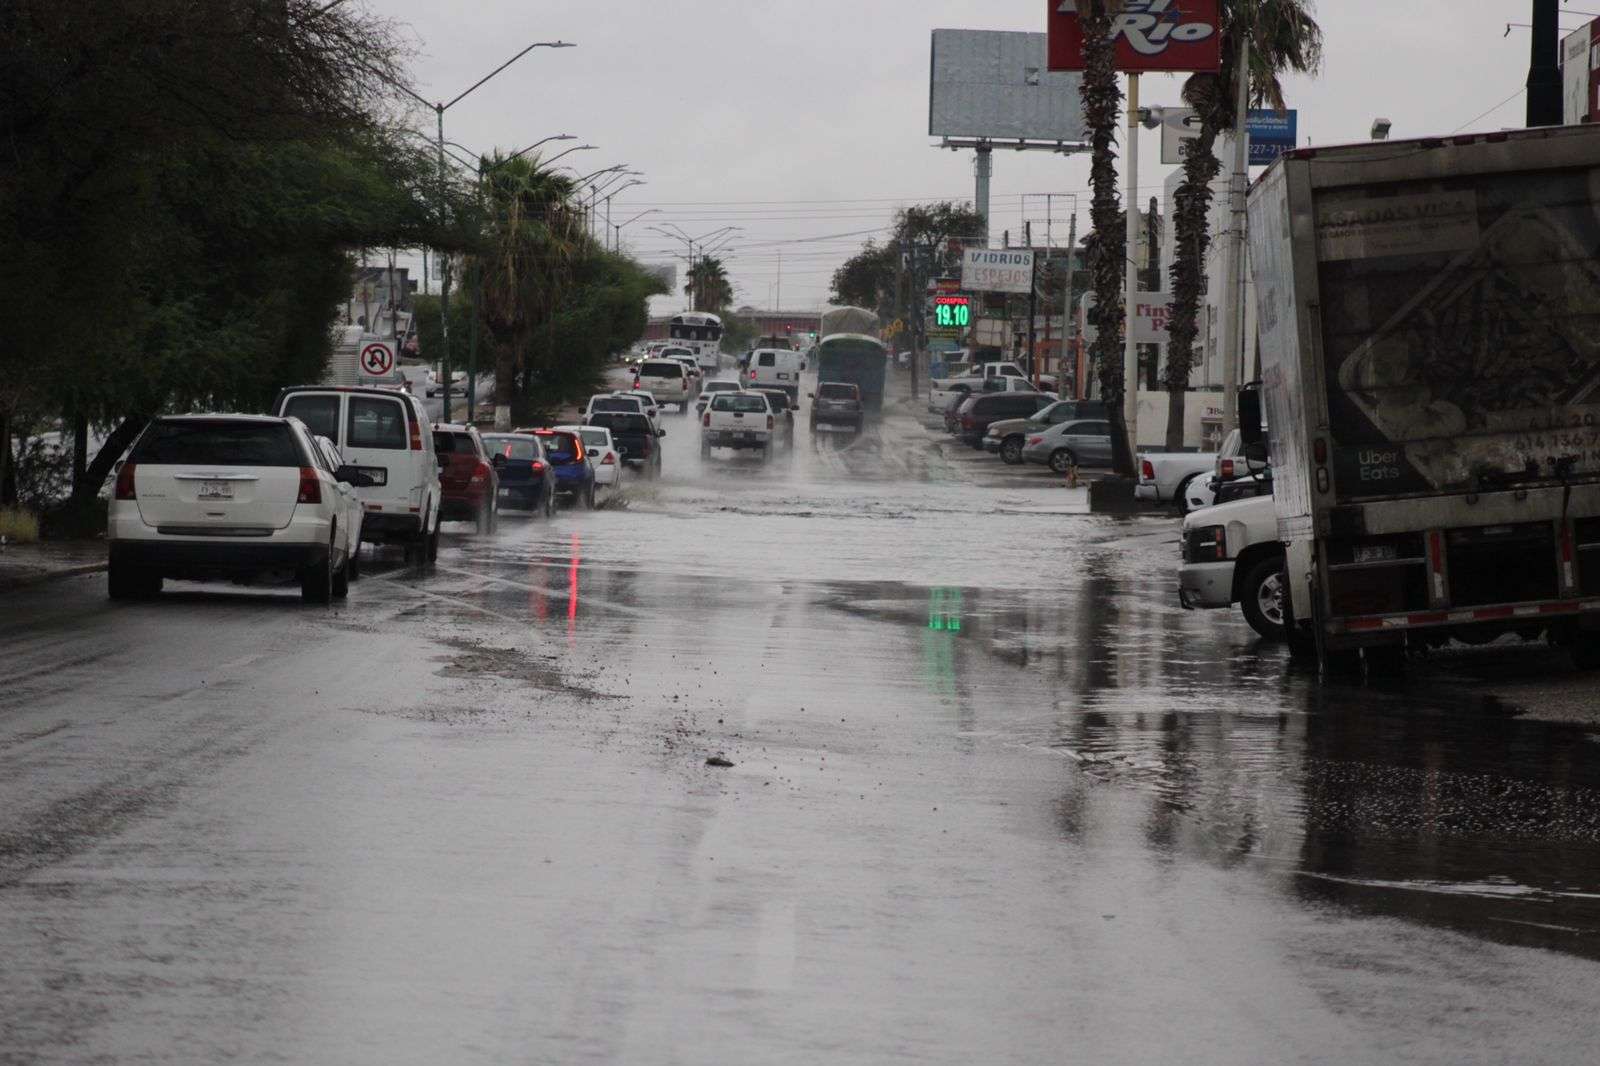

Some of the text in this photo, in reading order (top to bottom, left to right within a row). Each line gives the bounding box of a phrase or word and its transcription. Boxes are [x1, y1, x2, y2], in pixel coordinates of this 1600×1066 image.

[971, 252, 1031, 266] VIDRIOS
[975, 268, 1029, 283] ESPEJOS
[936, 304, 968, 326] 19.10
[1359, 449, 1397, 464] Uber
[1360, 465, 1400, 480] Eats
